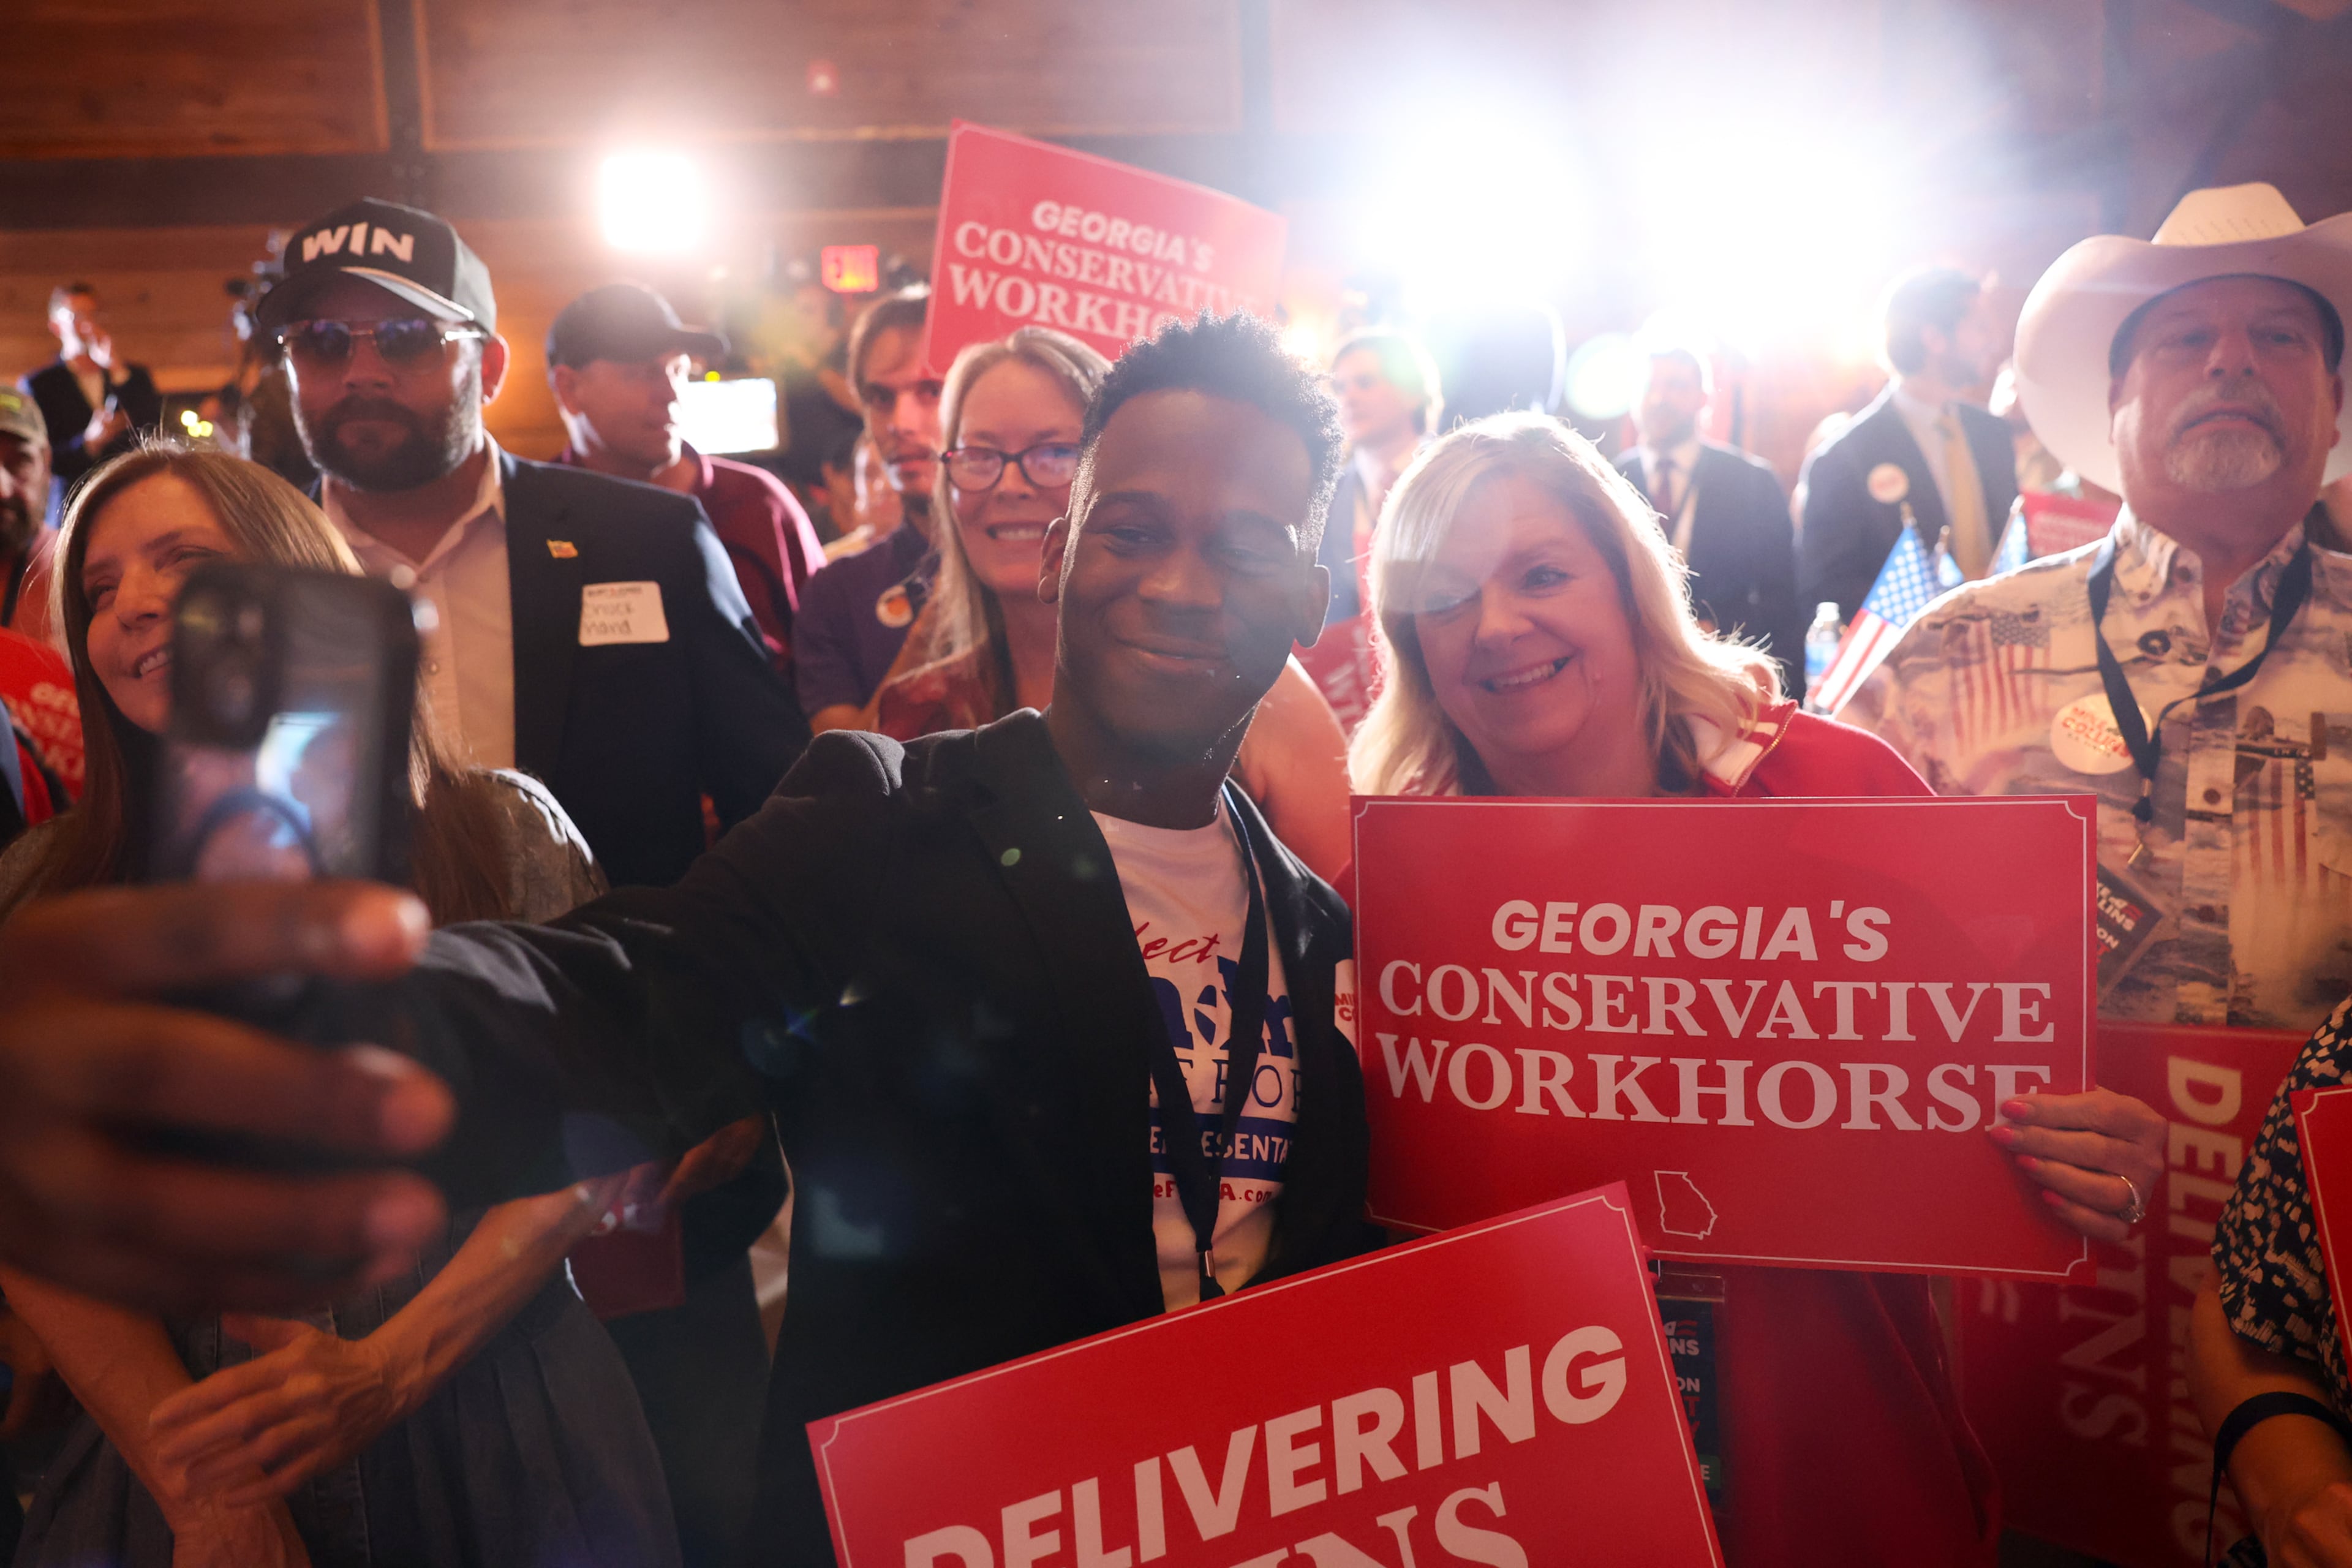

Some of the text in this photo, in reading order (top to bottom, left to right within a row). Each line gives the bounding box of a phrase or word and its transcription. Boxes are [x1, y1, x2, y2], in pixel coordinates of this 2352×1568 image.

[302, 221, 415, 263] WIN
[954, 221, 1259, 312] CONSERVATIV
[1031, 200, 1216, 273] GEORGIA'S
[1491, 899, 1891, 962] GEORGIA'S
[1379, 960, 2055, 1042] CONSERVATIVE
[1375, 1032, 2051, 1133] WORKHORSE
